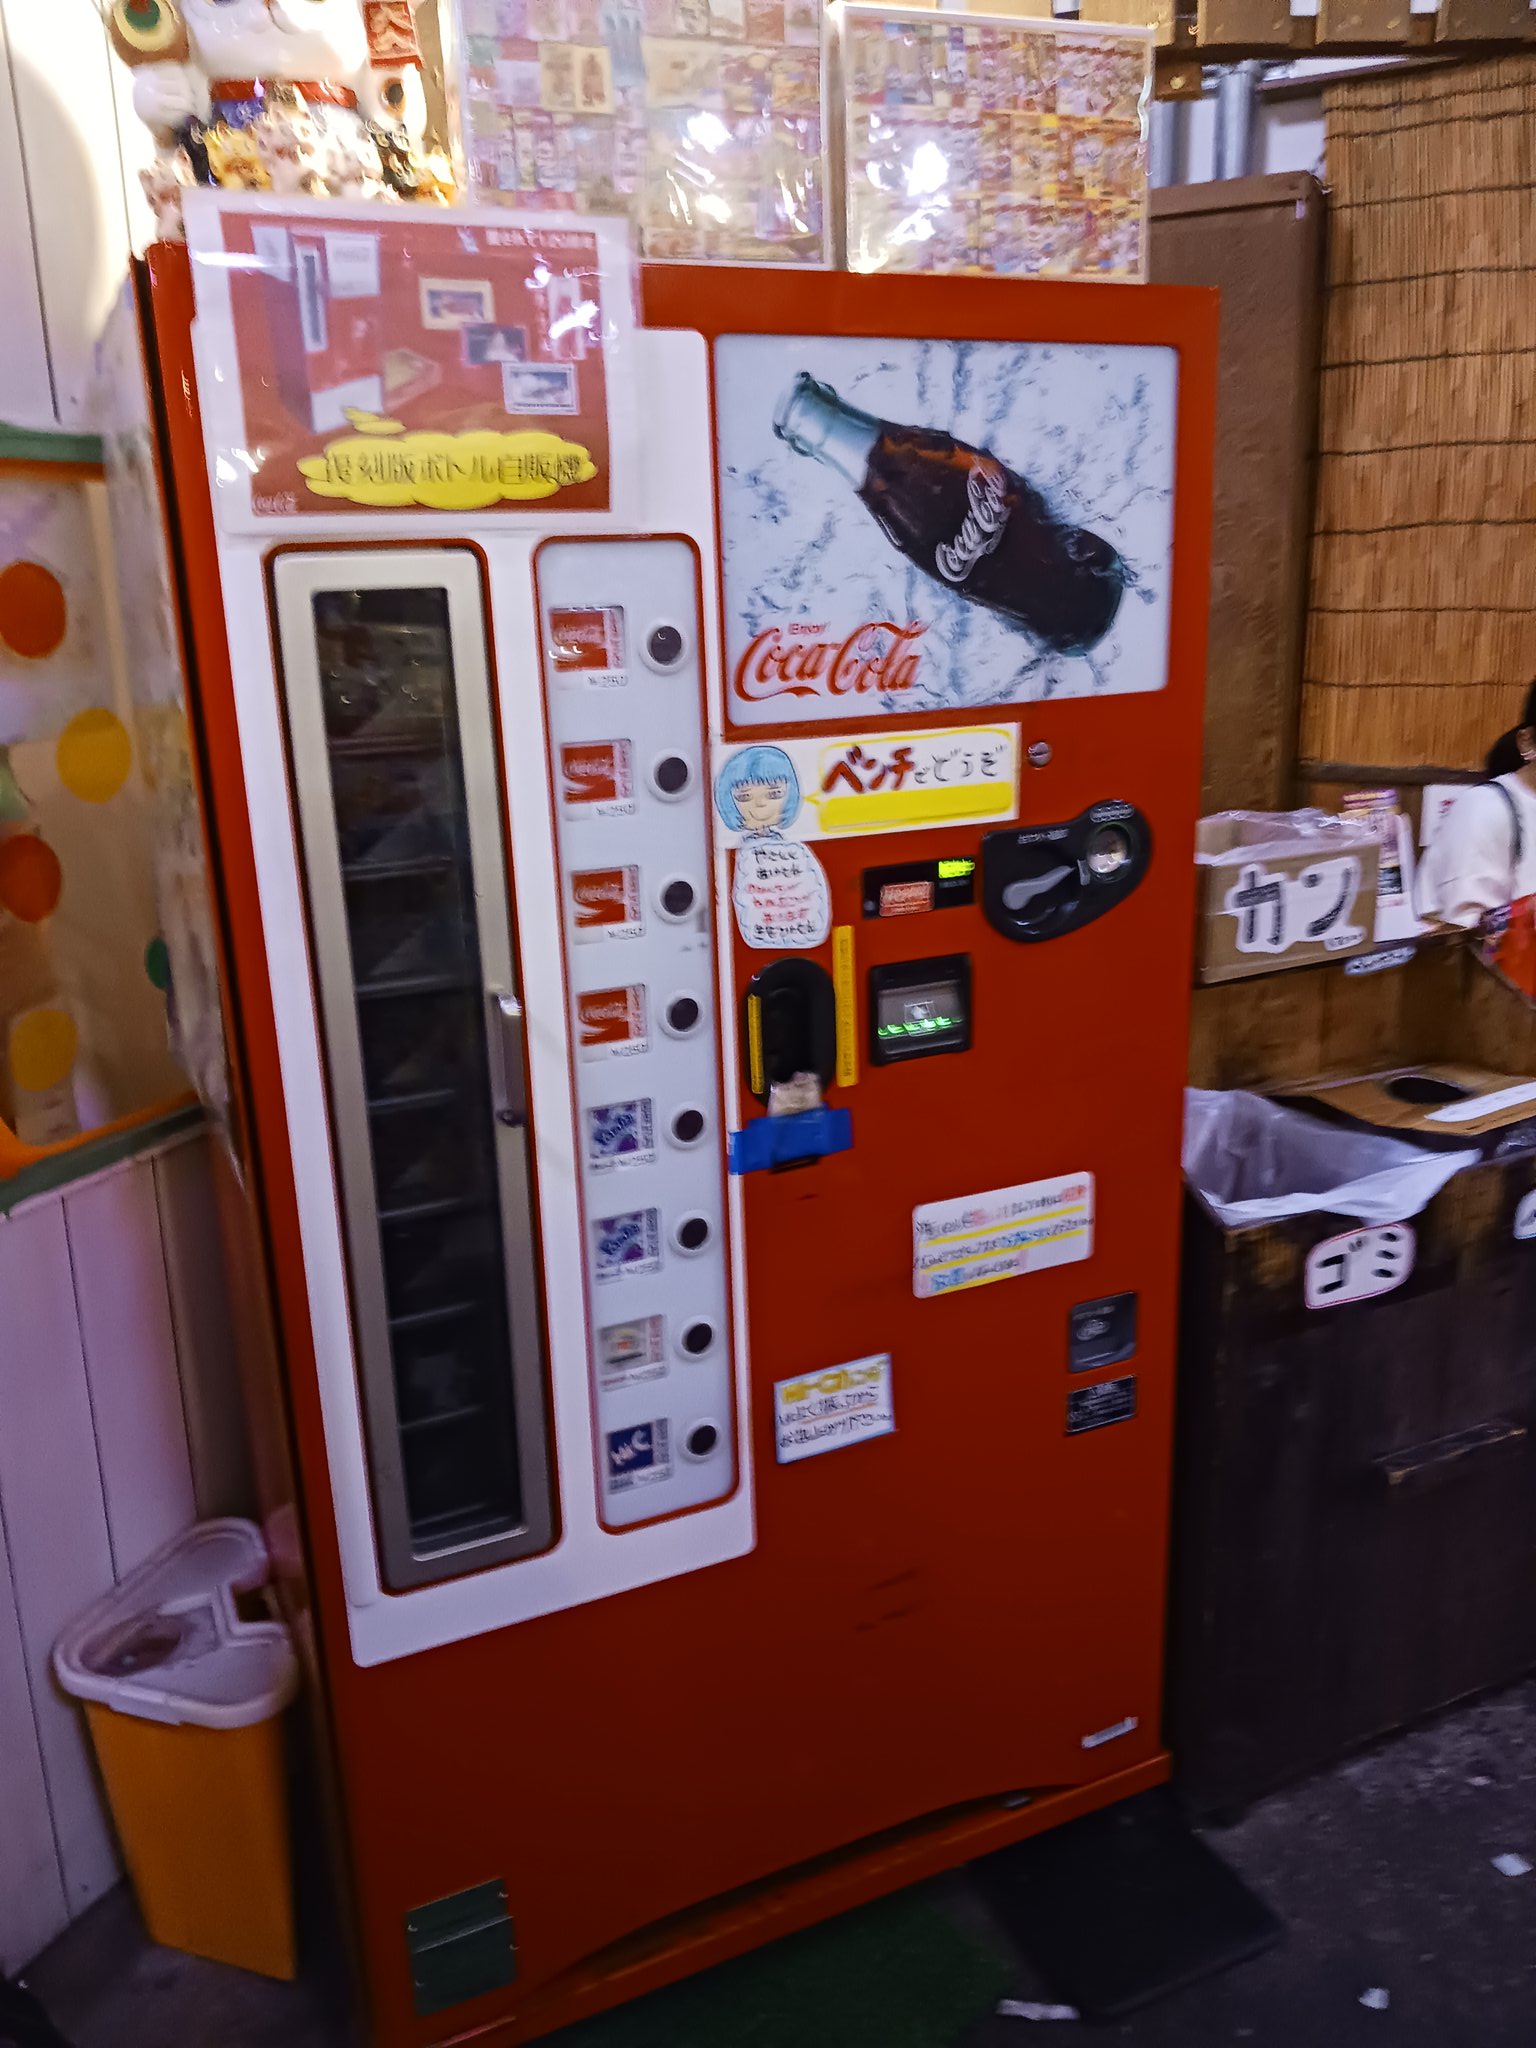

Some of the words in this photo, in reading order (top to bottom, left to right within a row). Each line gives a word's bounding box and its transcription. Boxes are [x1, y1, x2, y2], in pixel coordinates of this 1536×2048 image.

[734, 619, 930, 702] Coca-Cola
[1233, 868, 1353, 946] カン
[1316, 1232, 1403, 1295] ゴミ
